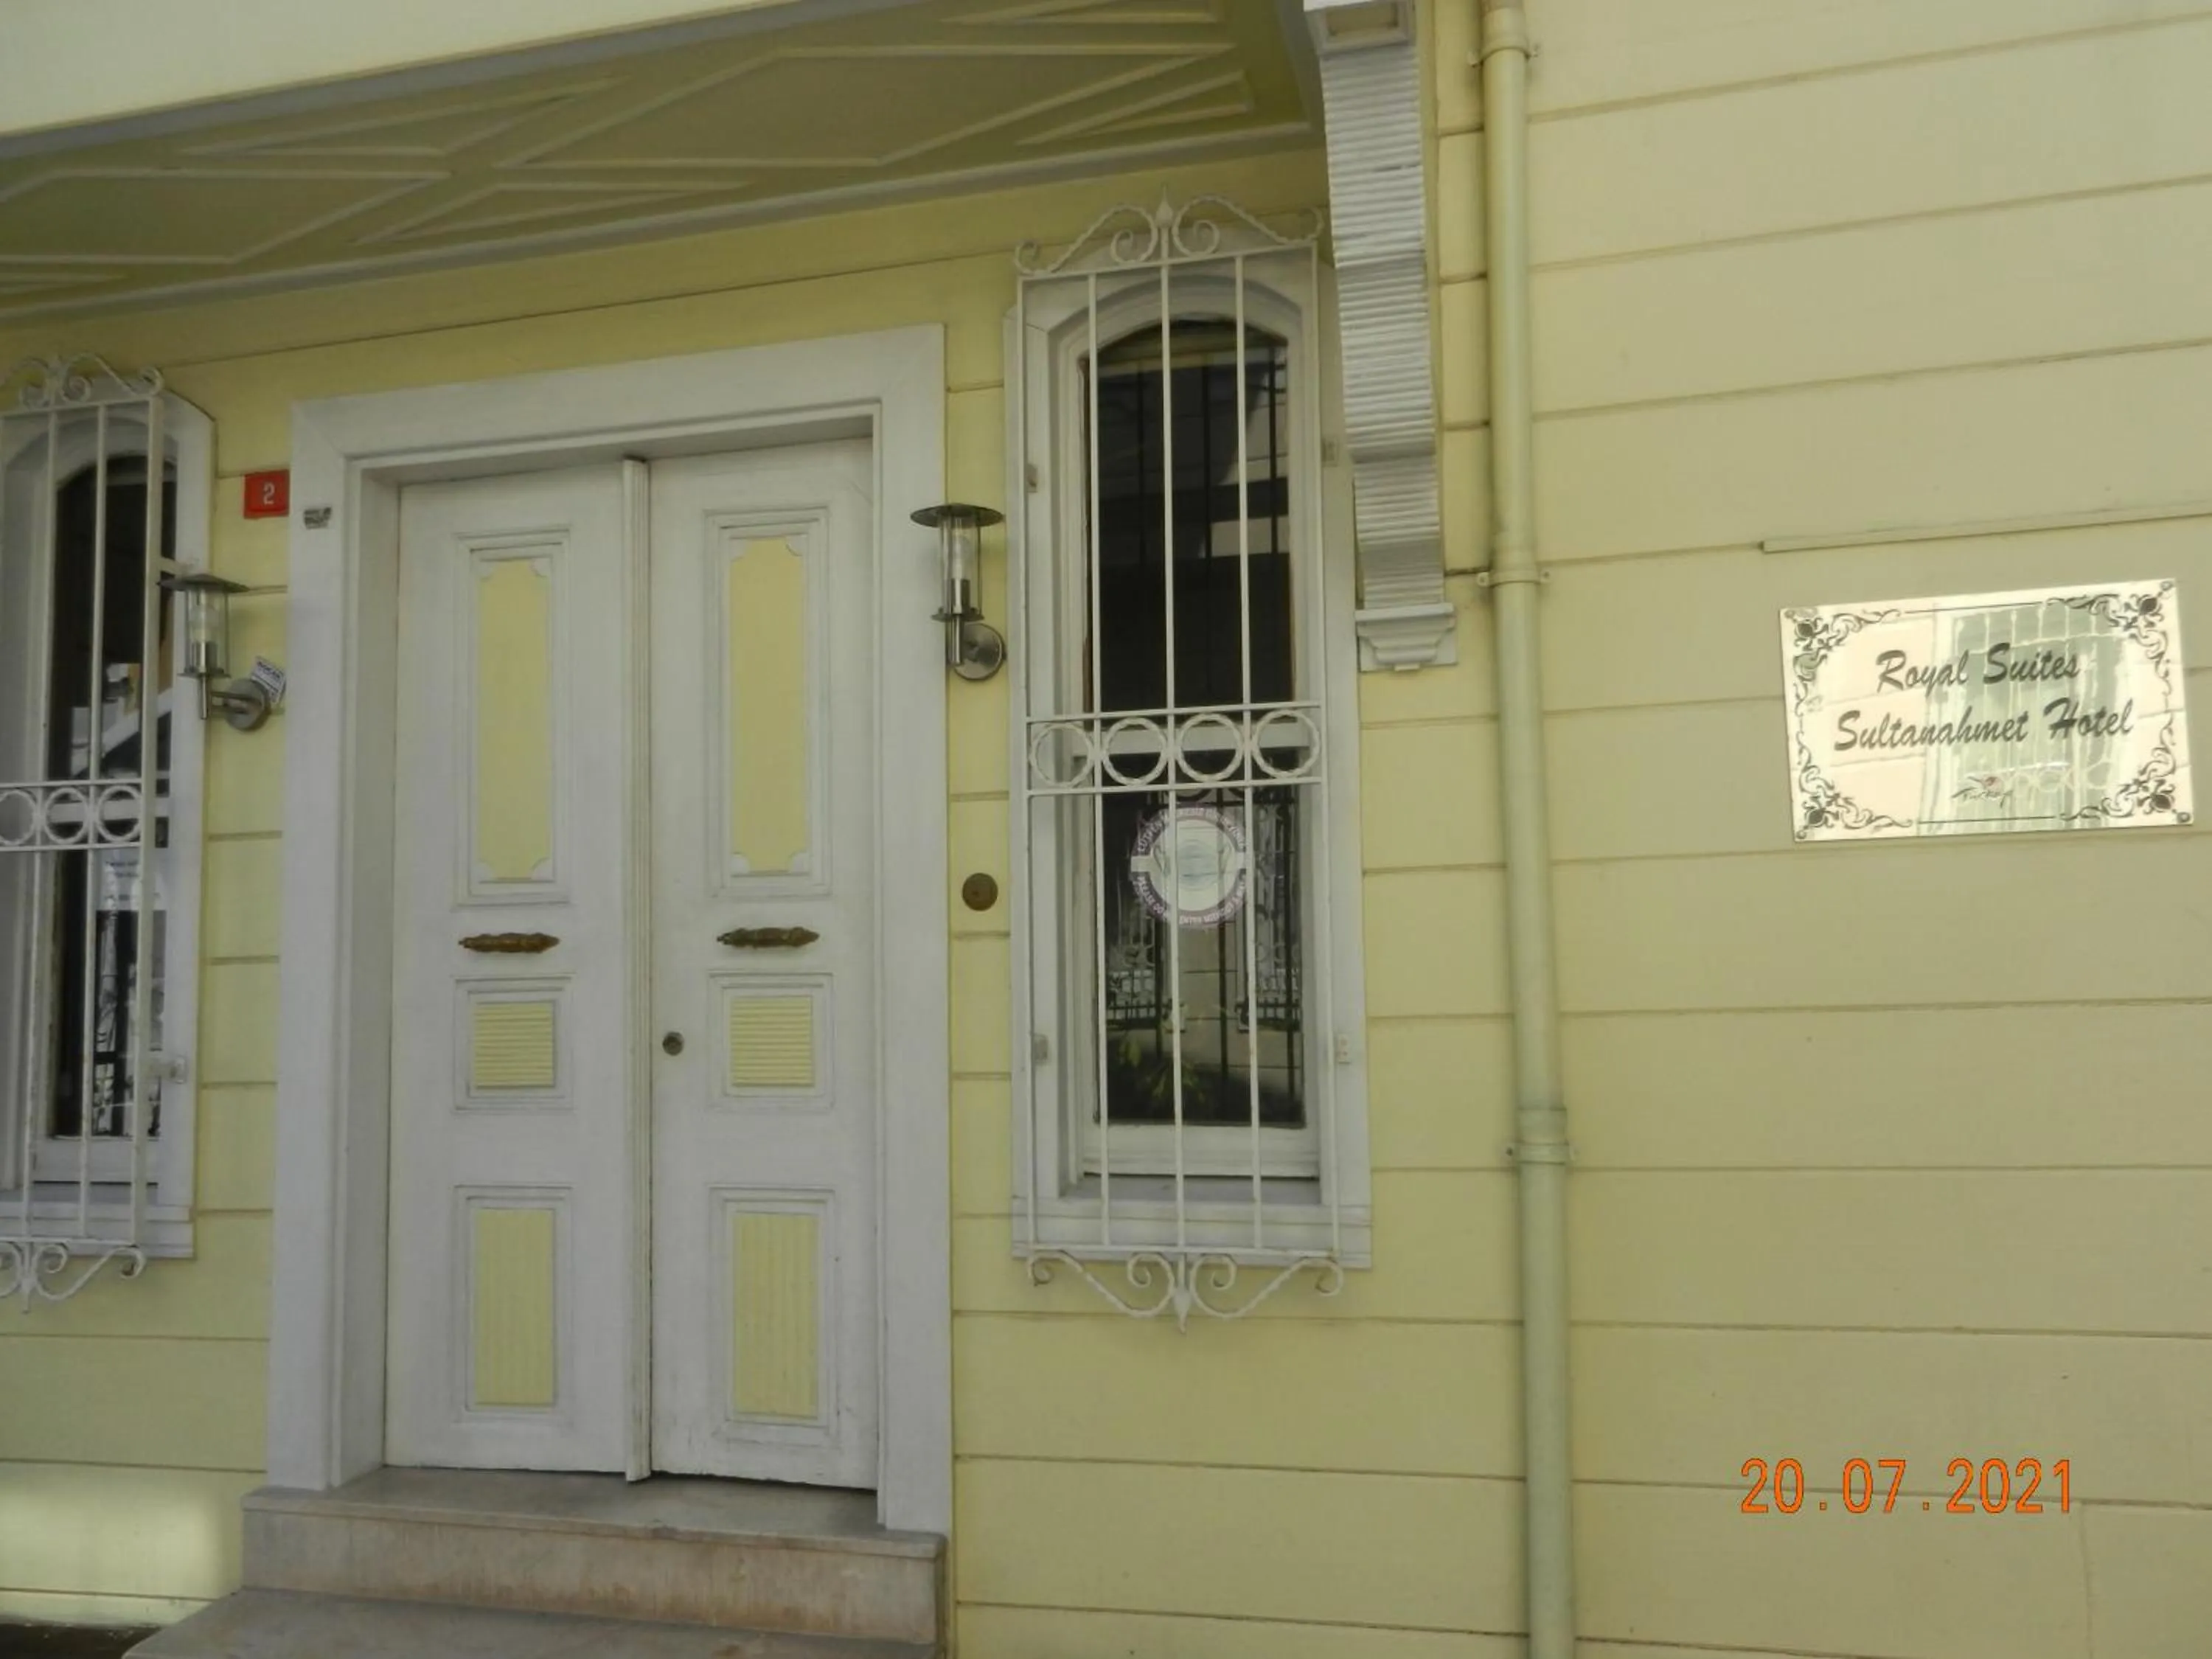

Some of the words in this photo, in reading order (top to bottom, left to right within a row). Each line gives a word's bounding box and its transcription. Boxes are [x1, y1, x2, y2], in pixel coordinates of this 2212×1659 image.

[262, 481, 275, 505] 2
[1876, 649, 1969, 698] Royal
[1982, 641, 2081, 684] Suites
[1834, 706, 2030, 751] Sultanahmet
[2043, 697, 2133, 738] Hotel
